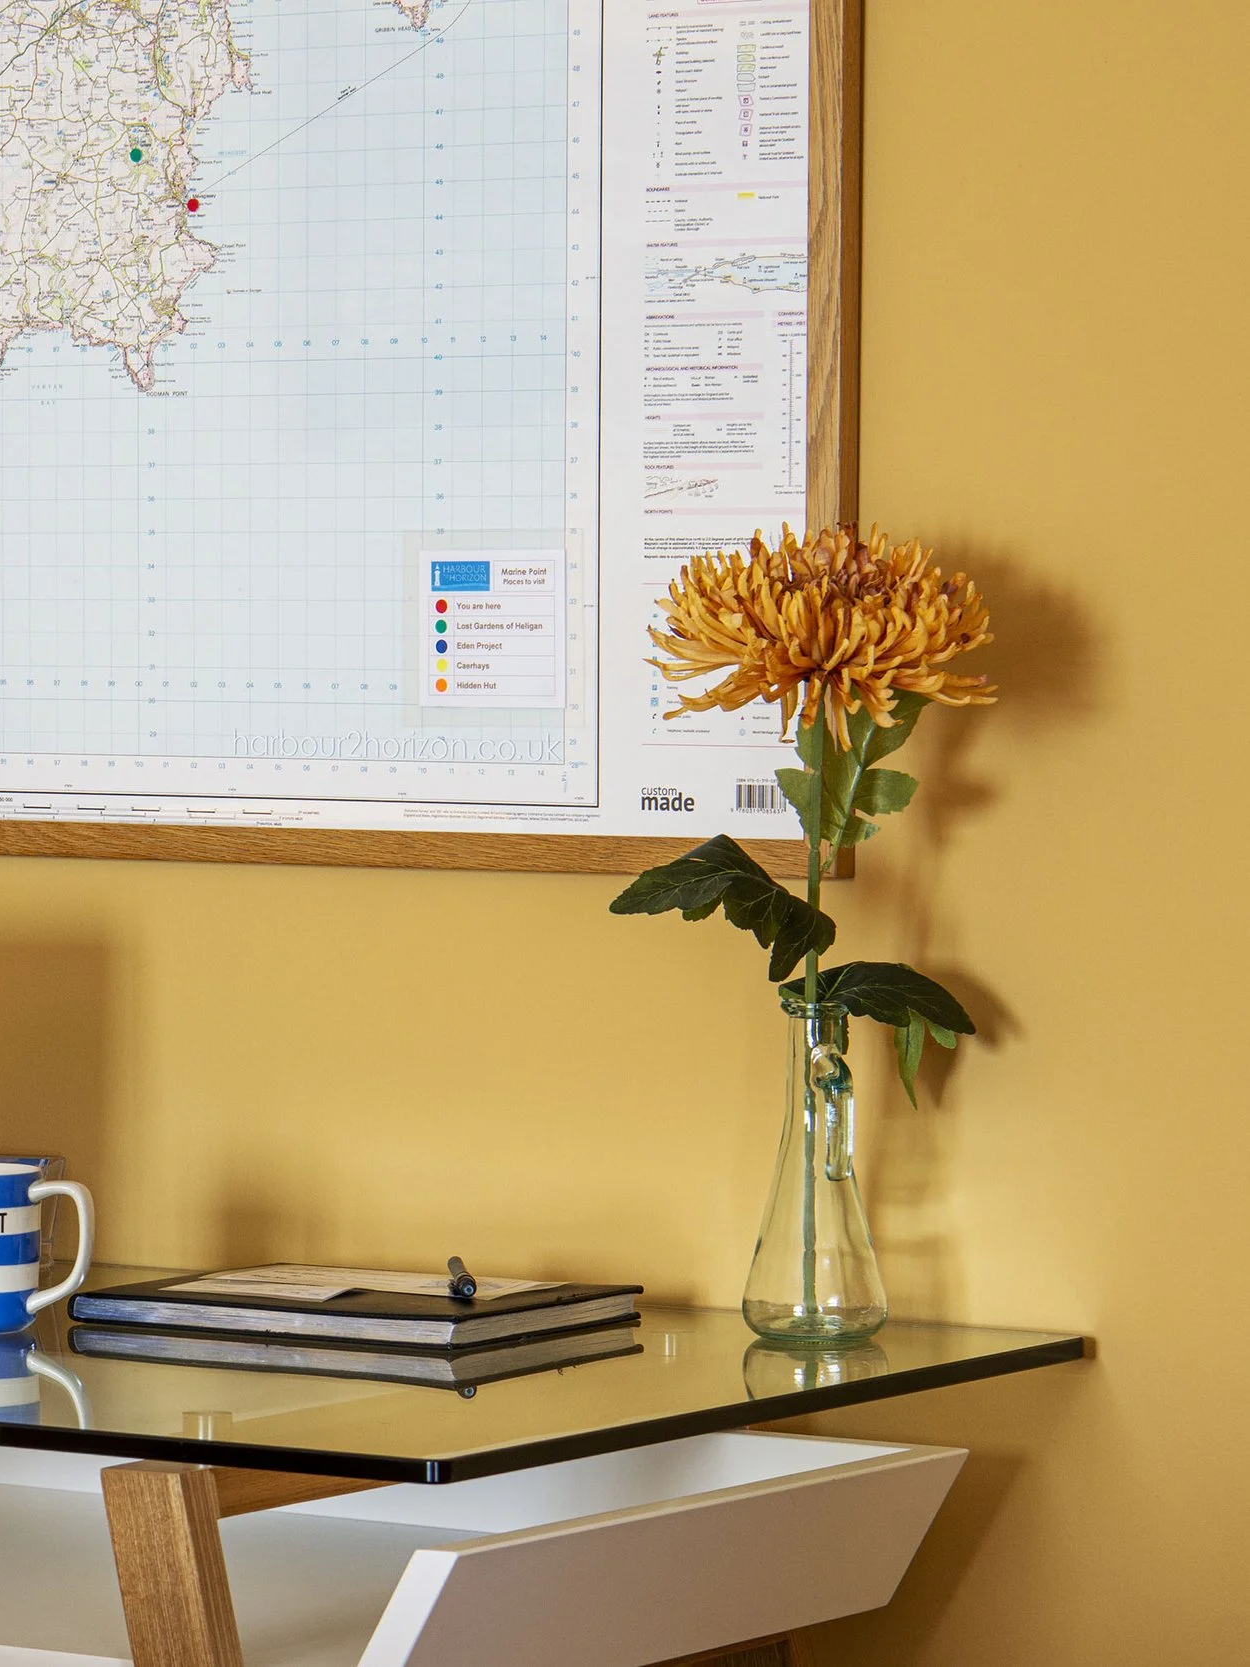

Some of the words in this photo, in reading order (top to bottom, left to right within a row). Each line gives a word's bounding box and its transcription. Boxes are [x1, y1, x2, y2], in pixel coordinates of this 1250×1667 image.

[443, 564, 486, 574] HARBOUR
[450, 574, 486, 582] HORIZON
[516, 622, 542, 632] Heligan
[476, 642, 502, 652] Project
[457, 662, 490, 671] Caerhays
[234, 729, 562, 762] harbour2horizon.co.uk
[641, 787, 677, 796] custom
[641, 792, 695, 812] made
